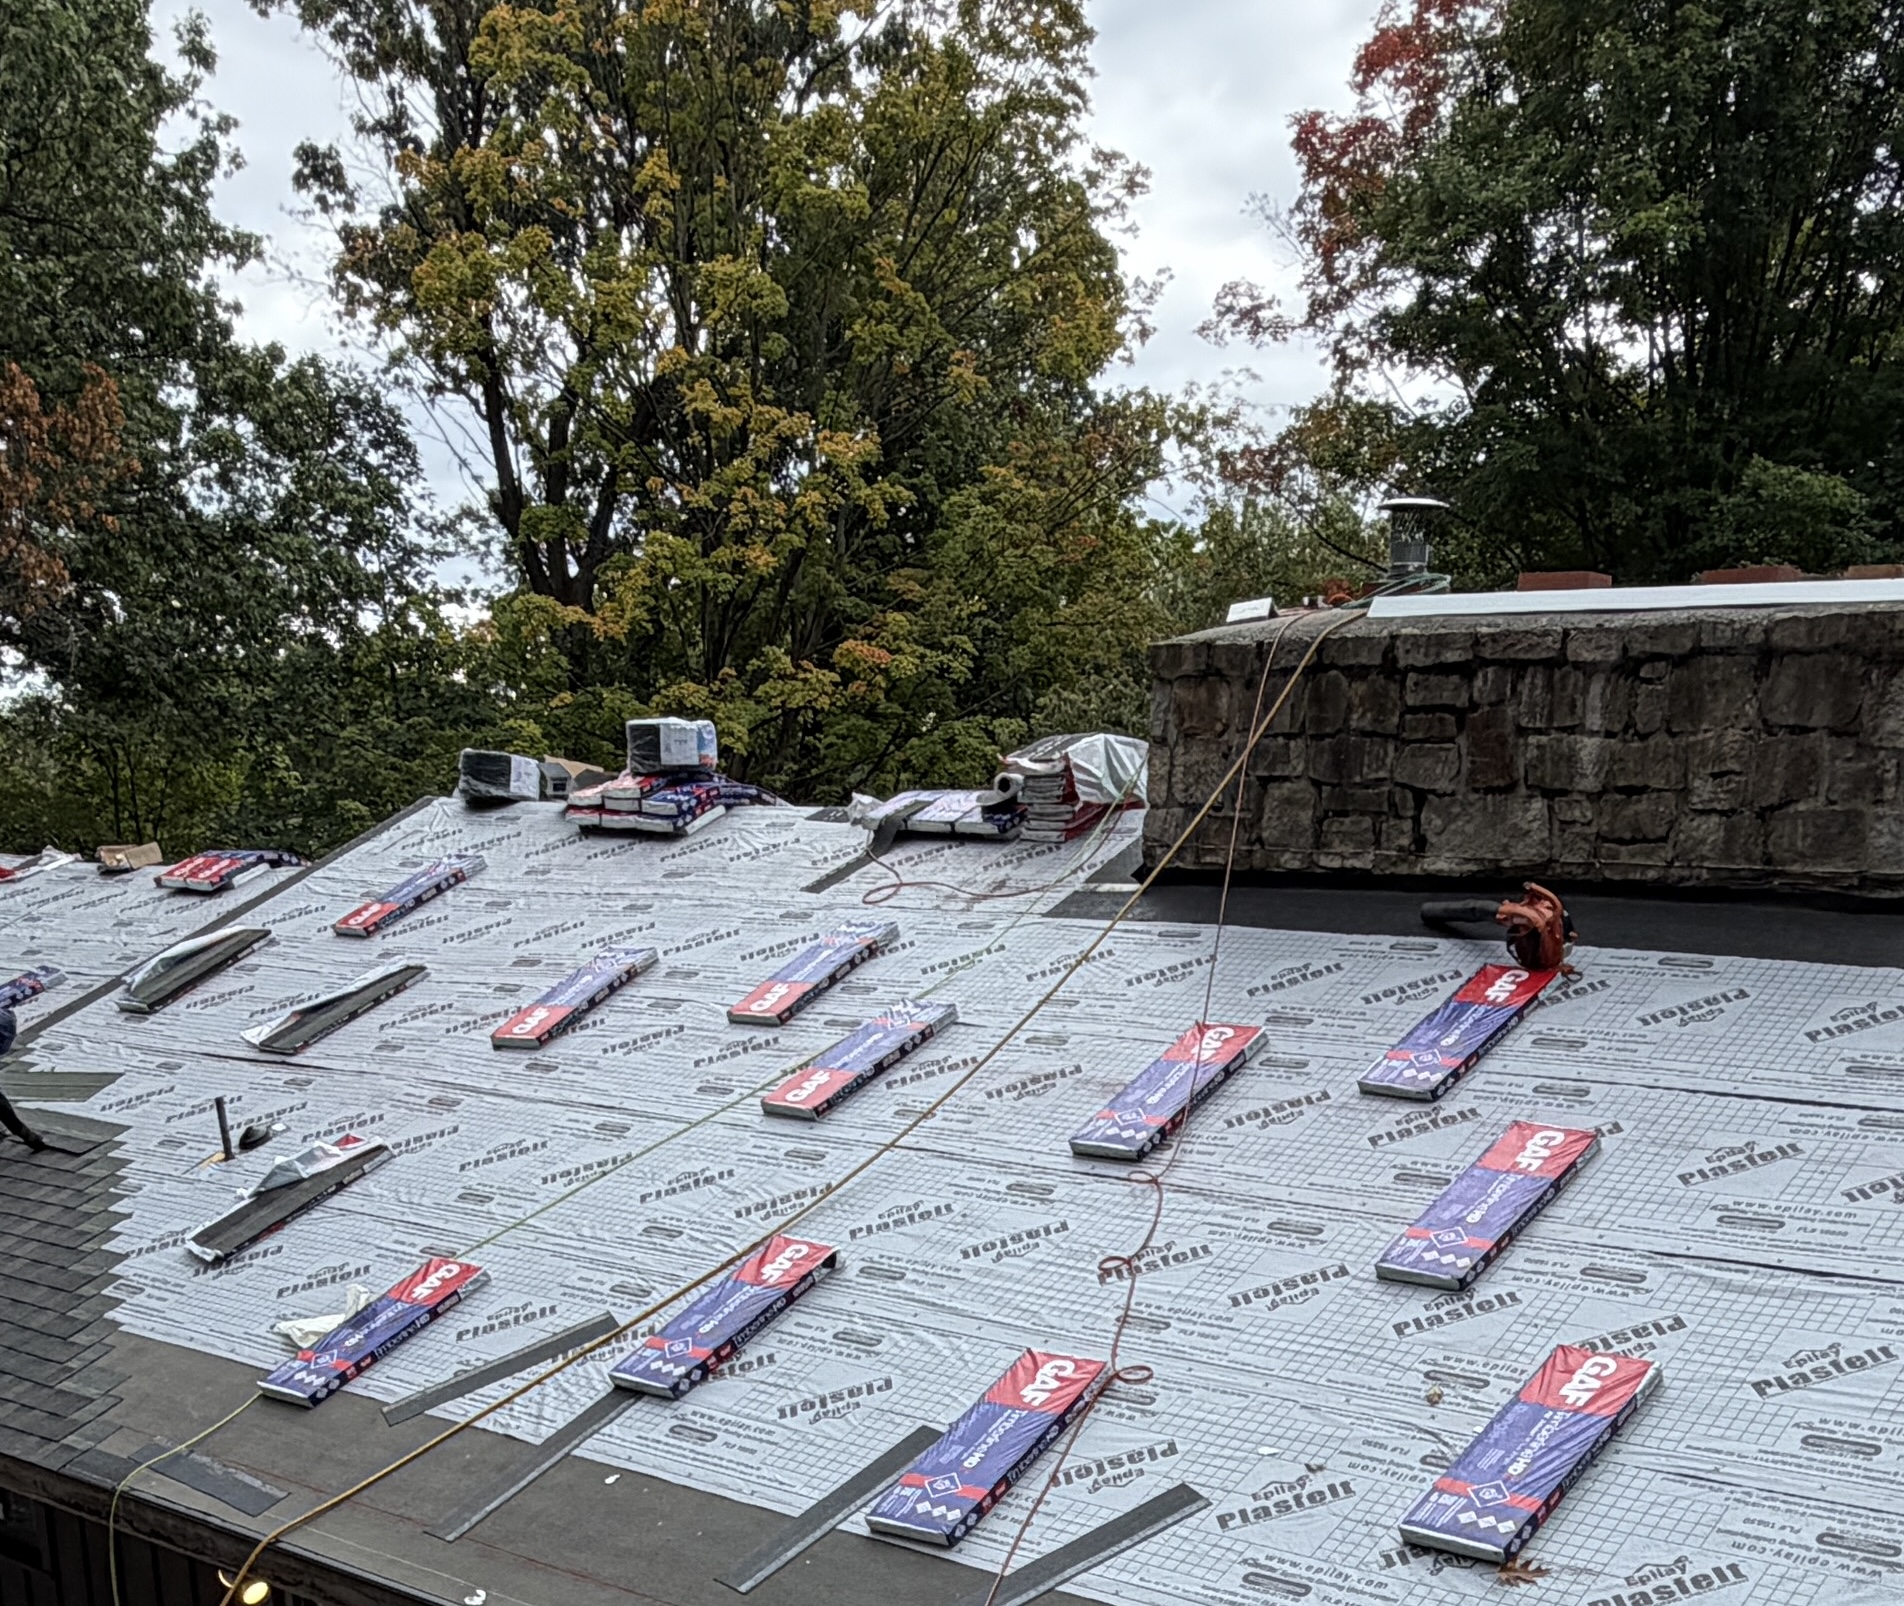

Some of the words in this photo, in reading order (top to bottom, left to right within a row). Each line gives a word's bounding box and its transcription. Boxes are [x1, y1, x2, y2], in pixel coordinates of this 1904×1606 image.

[749, 983, 793, 1010] GAF
[1477, 969, 1528, 1002] GAF
[511, 1009, 550, 1034] GAF
[784, 1070, 831, 1101] GAF
[1514, 1131, 1565, 1173] GAF
[408, 1262, 462, 1301] GAF
[760, 1244, 810, 1284] GAF
[1021, 1360, 1077, 1406] GAF
[1558, 1356, 1618, 1406] GAF
